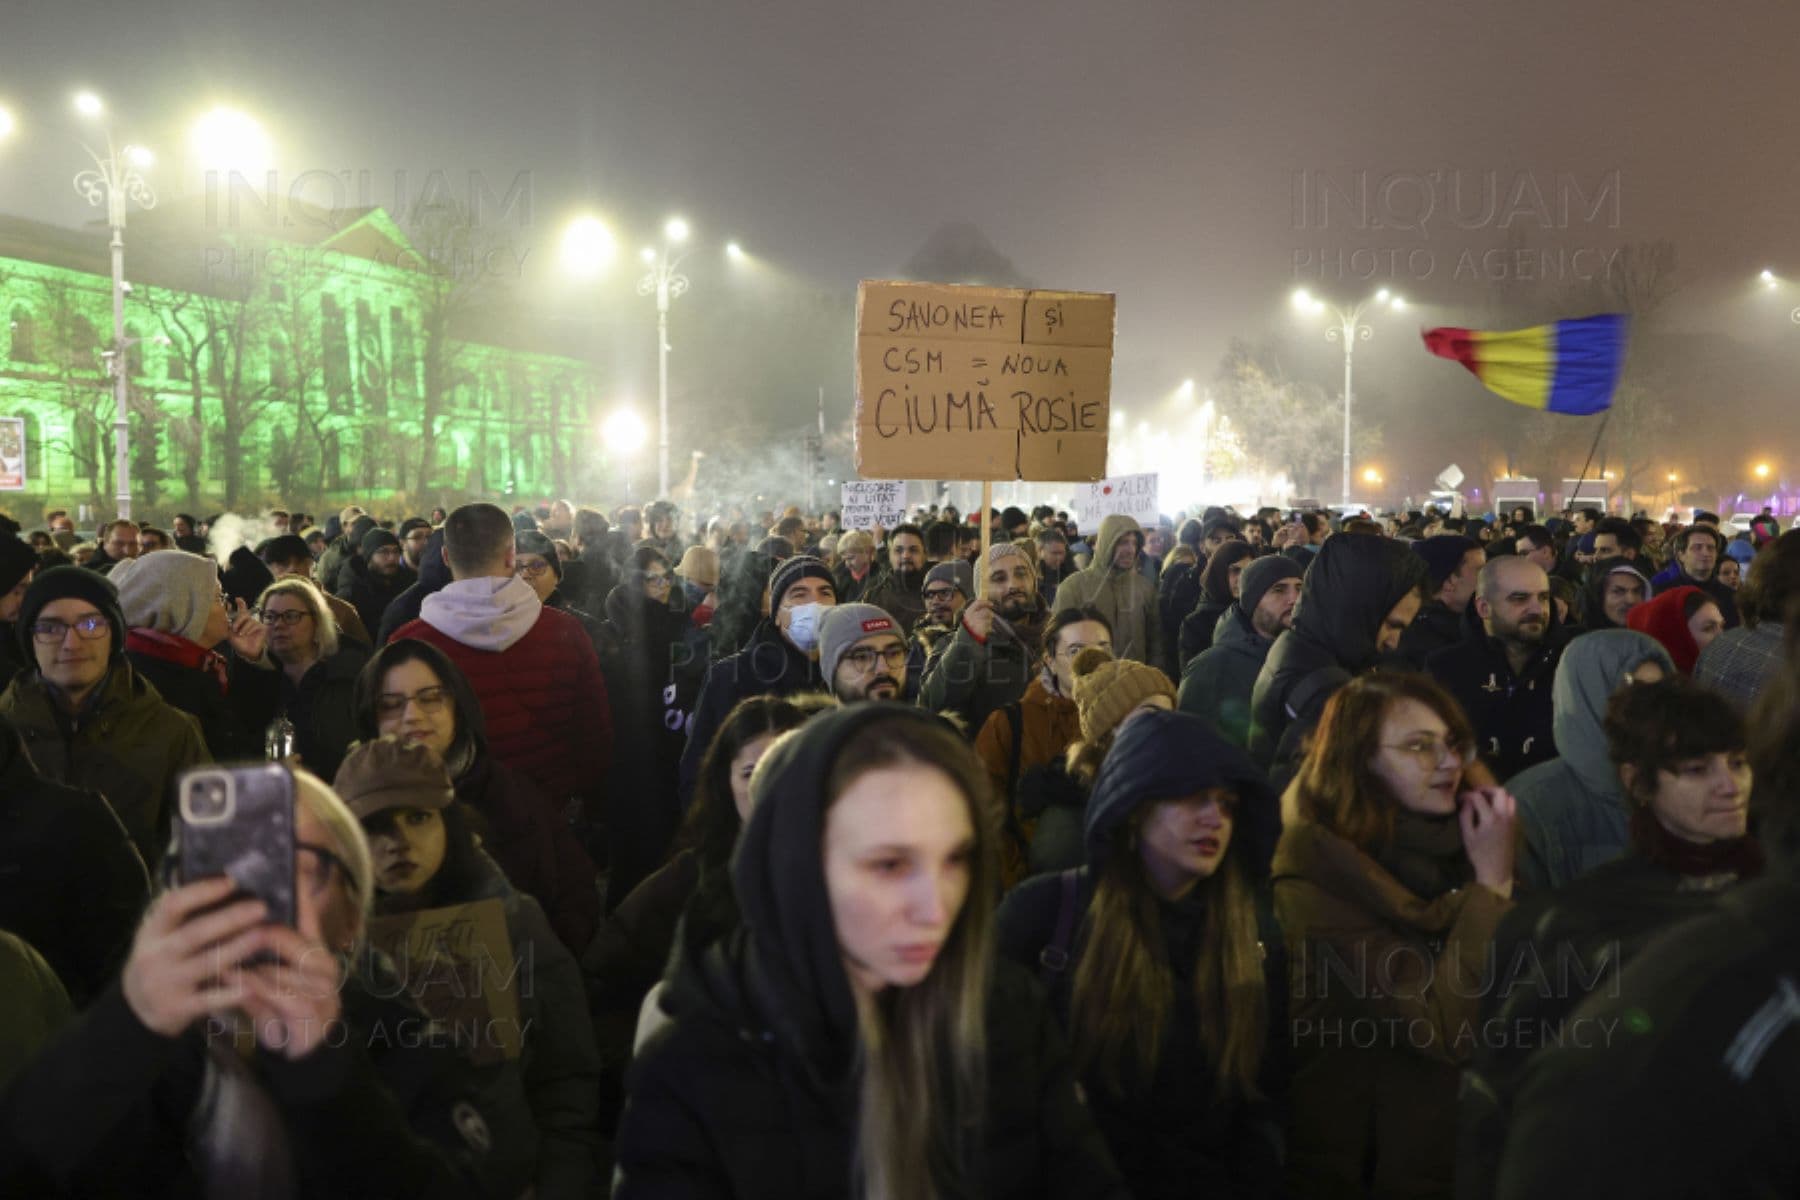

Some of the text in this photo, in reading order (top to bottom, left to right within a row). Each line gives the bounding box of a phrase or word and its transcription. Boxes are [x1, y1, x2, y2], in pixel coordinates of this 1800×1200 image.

[888, 299, 1004, 332] SAVONEA
[883, 347, 943, 374] CSM
[971, 357, 988, 369] =
